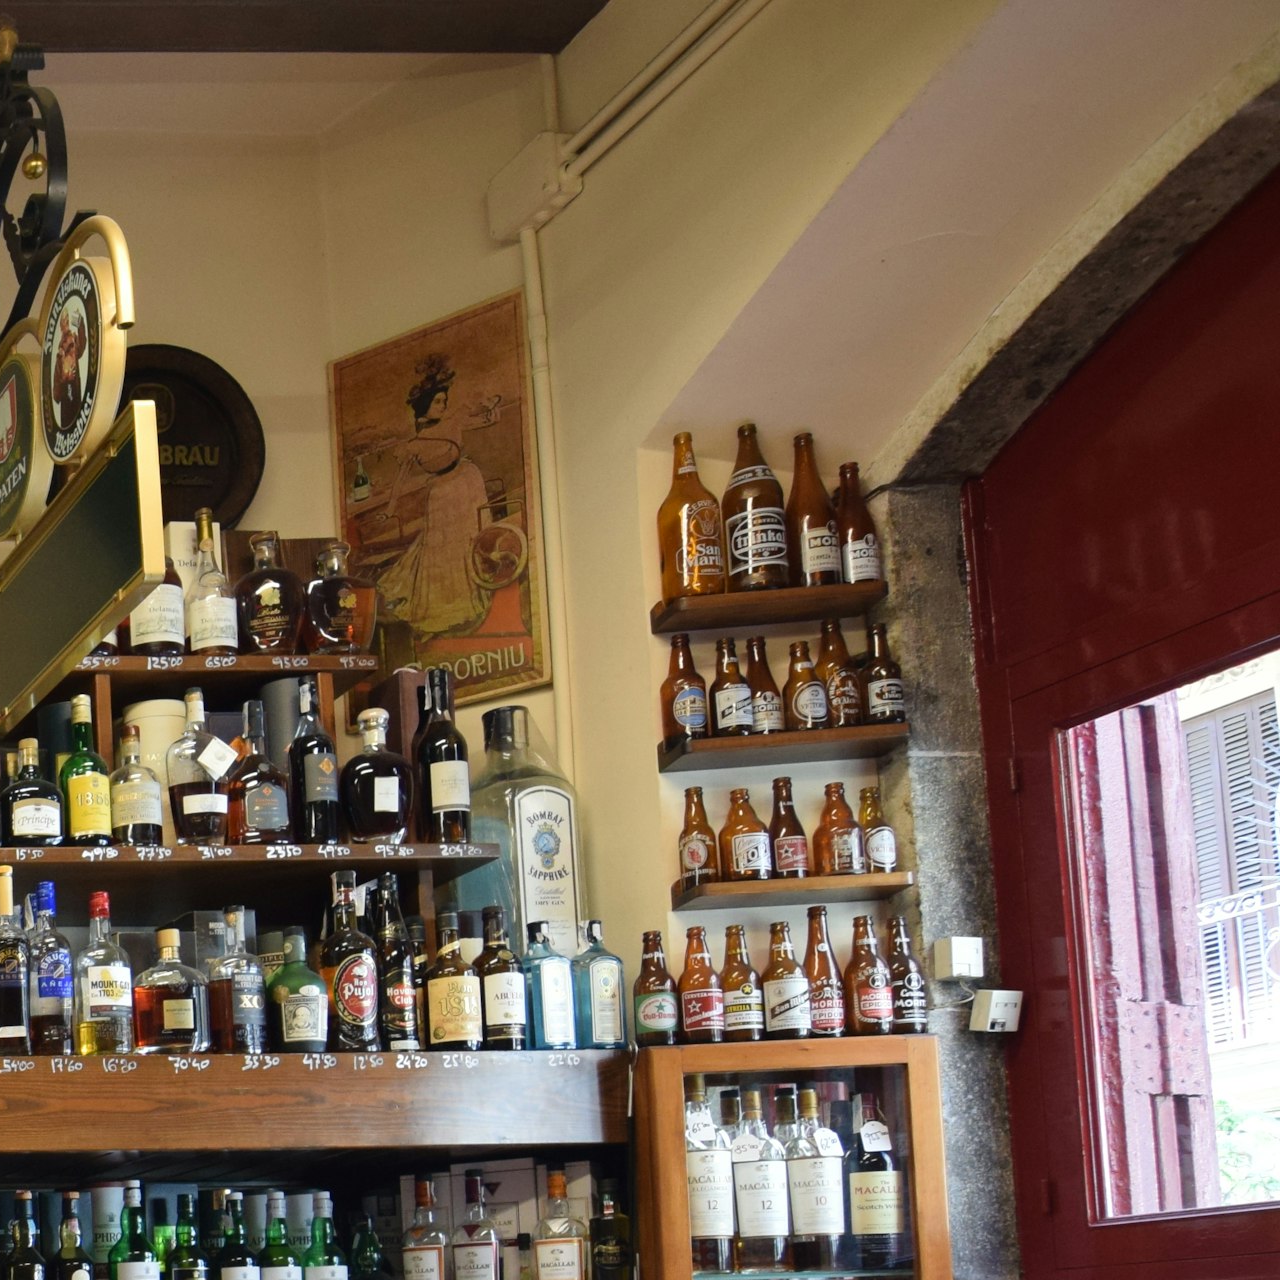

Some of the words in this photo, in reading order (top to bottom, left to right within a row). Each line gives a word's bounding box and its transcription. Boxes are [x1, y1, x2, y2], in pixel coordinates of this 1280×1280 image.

[54, 391, 93, 457] Weissbier
[147, 655, 183, 669] 125'00
[526, 805, 565, 827] BOMBAY
[528, 866, 570, 882] SAPPHIRE
[344, 984, 374, 998] Pujol
[812, 1000, 842, 1009] MORITZ
[302, 1055, 337, 1070] 47'50
[443, 1055, 478, 1069] 25'80
[708, 1200, 718, 1210] 12
[762, 1200, 772, 1209] 12
[816, 1197, 826, 1205] 10
